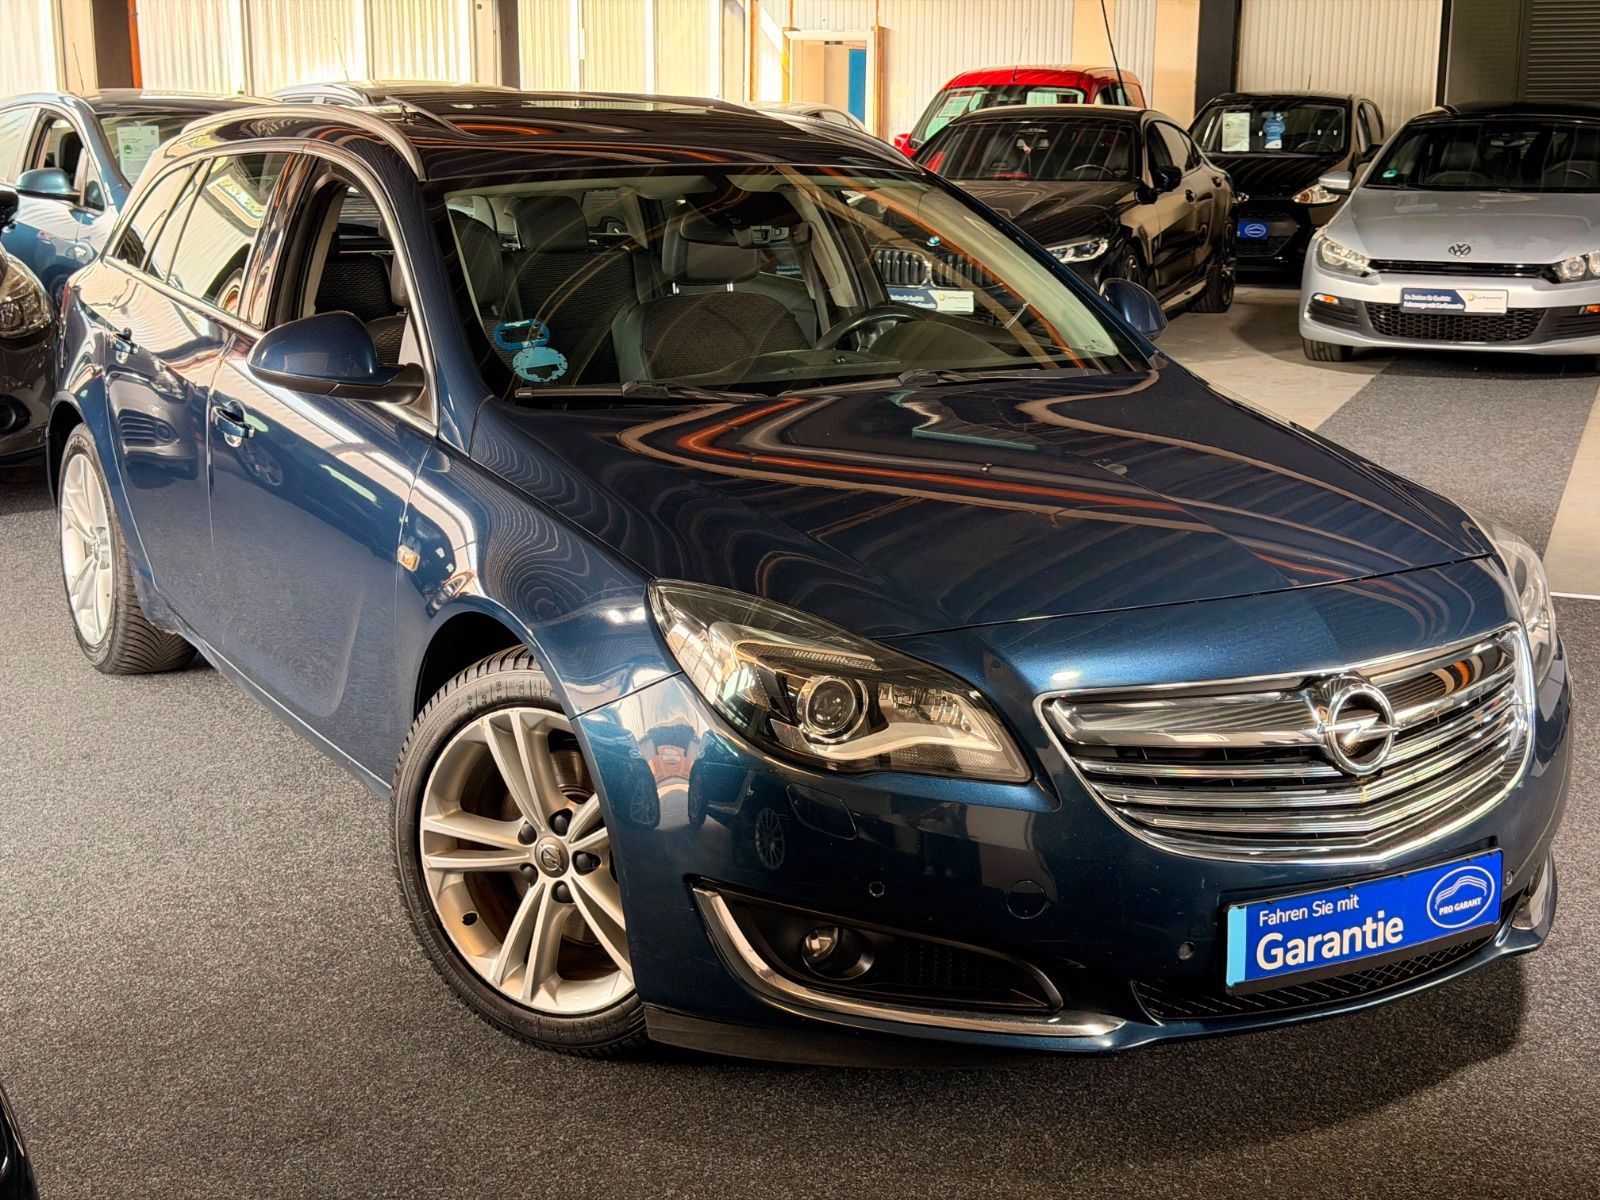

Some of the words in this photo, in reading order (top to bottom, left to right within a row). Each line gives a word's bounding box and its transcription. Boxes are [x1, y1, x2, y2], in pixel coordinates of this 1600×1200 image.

[1259, 907, 1308, 927] Fahren
[1312, 900, 1334, 917] Sie
[1337, 894, 1360, 912] mit
[1439, 905, 1453, 916] PRO
[1454, 897, 1482, 911] GARANT
[1256, 910, 1403, 970] Garantie
